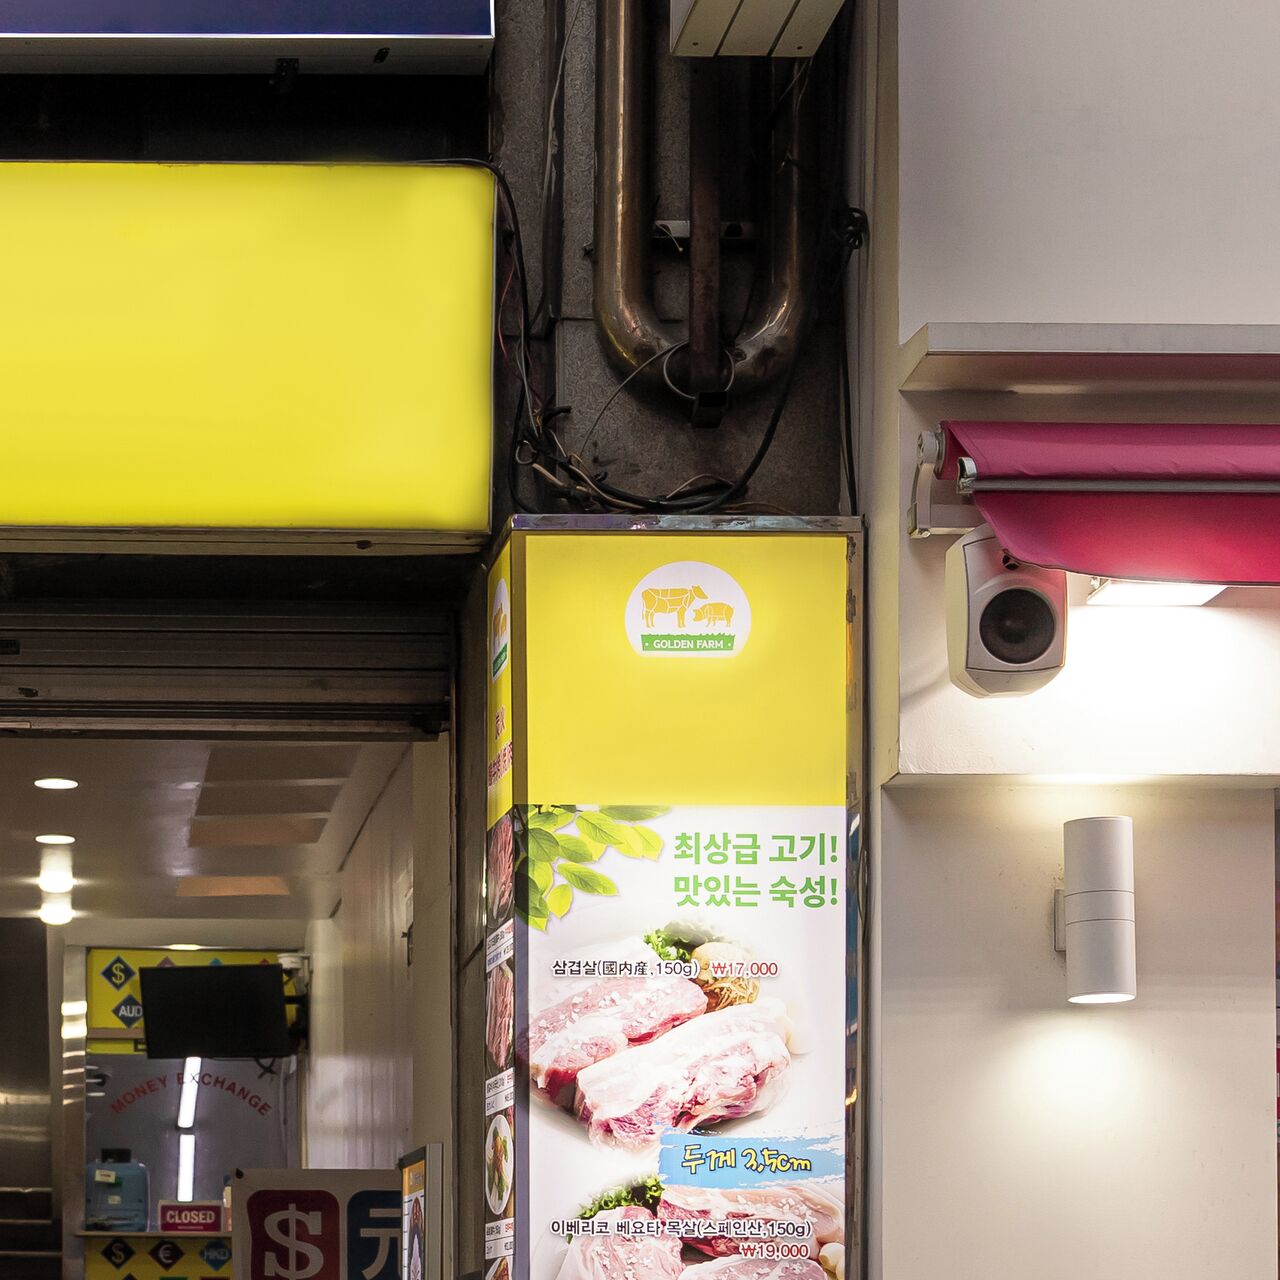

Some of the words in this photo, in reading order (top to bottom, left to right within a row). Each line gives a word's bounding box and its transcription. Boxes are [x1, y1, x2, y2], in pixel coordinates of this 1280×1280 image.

[653, 638, 694, 650] GOLDEN
[696, 638, 724, 650] FARM
[673, 833, 761, 866] 최상급
[768, 833, 839, 865] 고기!
[673, 875, 761, 909] 맛있는
[768, 875, 839, 909] 숙성!
[712, 962, 778, 976] ₩17,000
[110, 1075, 168, 1114] MONEY
[166, 1210, 215, 1223] CLOSED
[551, 1220, 610, 1236] 이베리코
[616, 1220, 660, 1236] 베요타
[666, 1220, 812, 1238] 목살(스페인산,150g)
[740, 1245, 809, 1260] ₩19,000
